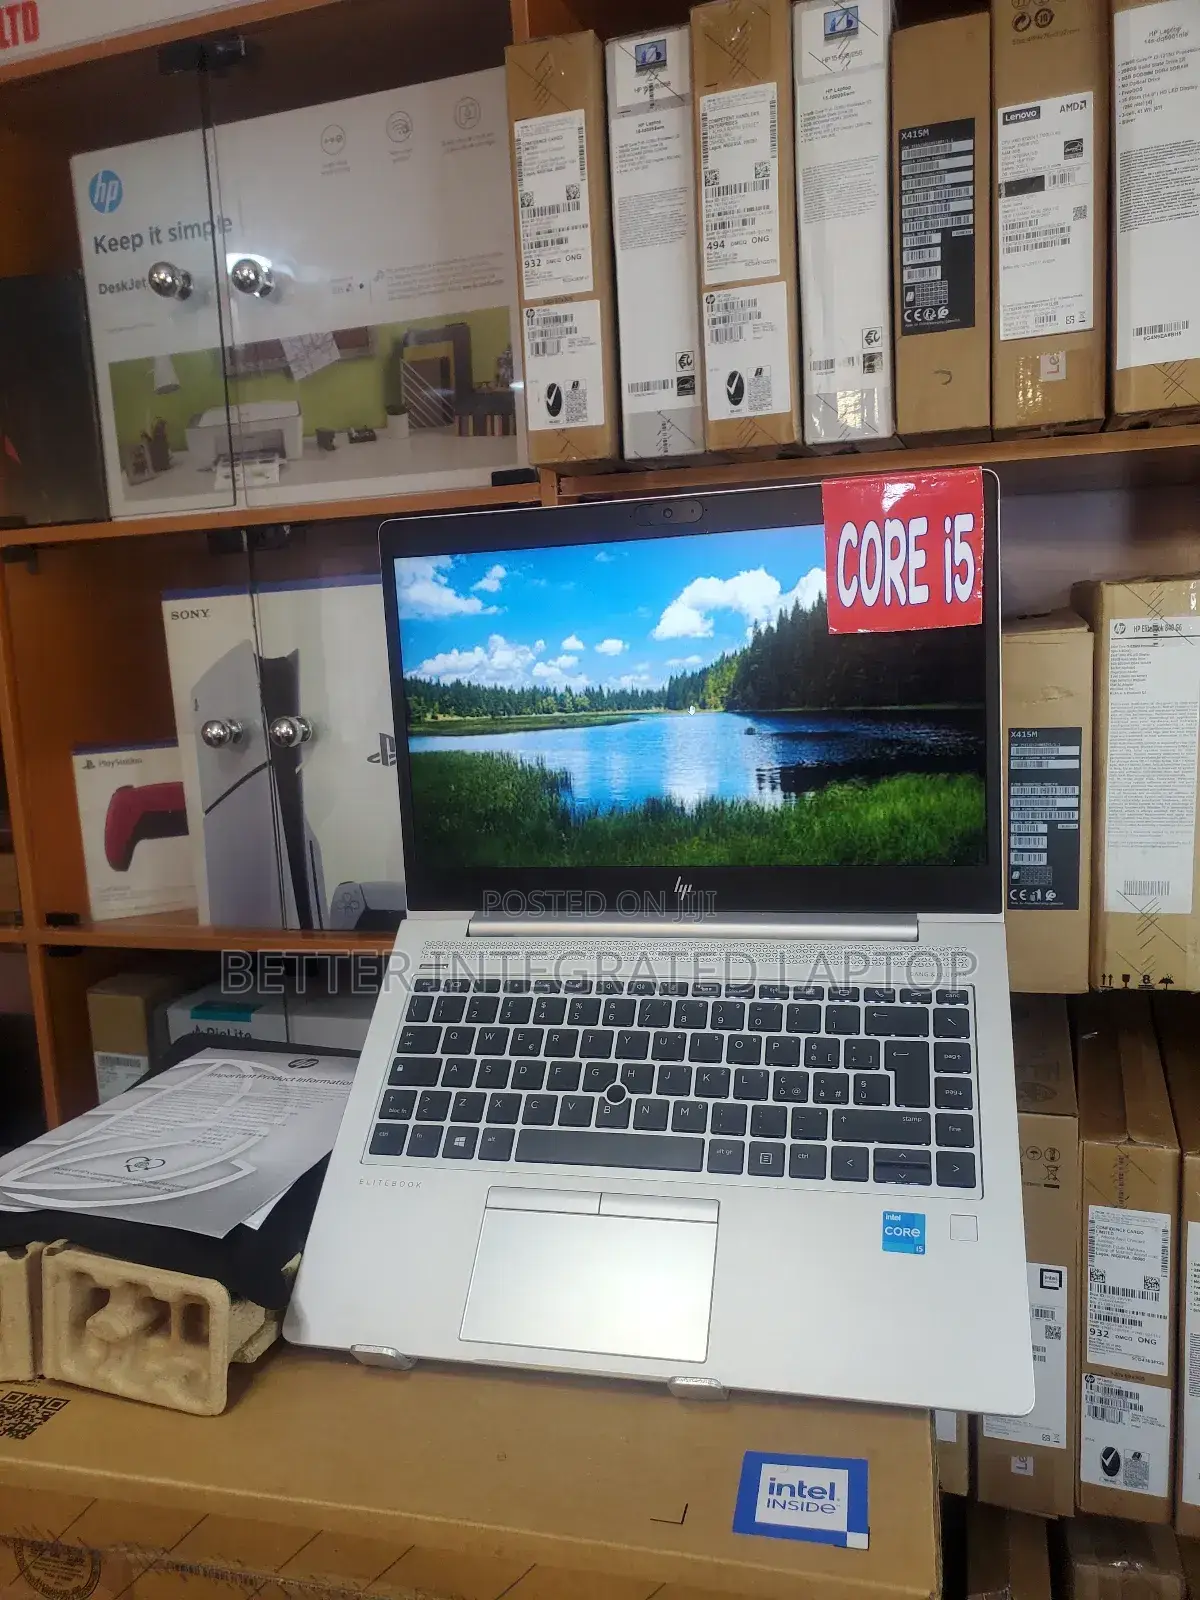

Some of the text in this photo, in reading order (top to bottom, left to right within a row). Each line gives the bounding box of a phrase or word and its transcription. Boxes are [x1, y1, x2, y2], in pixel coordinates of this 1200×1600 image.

[1005, 102, 1080, 122] Lenovo AMD
[901, 128, 930, 140] X415M
[93, 214, 234, 255] Keep it simple
[706, 239, 726, 250] 494
[751, 235, 770, 245] ONG
[524, 258, 542, 268] 932
[565, 253, 582, 262] ONG
[98, 277, 148, 296] DeskJet
[836, 512, 976, 608] CORE i5
[170, 608, 211, 621] SONY
[1133, 625, 1141, 633] HP
[471, 1010, 478, 1018] 2
[573, 1012, 580, 1020] 5
[608, 1013, 615, 1021] 6
[680, 1015, 687, 1023] 8
[717, 1016, 724, 1024] 9
[450, 1031, 458, 1040] Q
[484, 1032, 495, 1040] W
[517, 1033, 524, 1041] E
[552, 1034, 560, 1042] R
[587, 1035, 594, 1043] T
[623, 1036, 632, 1044] Y
[659, 1037, 667, 1045] U
[735, 1040, 743, 1049] O
[772, 1042, 780, 1050] P
[528, 1043, 535, 1051] €
[208, 1071, 257, 1082] Important
[257, 1073, 297, 1084] Product
[450, 1064, 458, 1073] A
[484, 1065, 492, 1073] S
[519, 1066, 528, 1074] D
[554, 1067, 562, 1075] F
[591, 1068, 600, 1076] G
[627, 1069, 636, 1078] H
[664, 1071, 671, 1080] J
[702, 1073, 711, 1082] K
[741, 1075, 748, 1084] L
[791, 1087, 801, 1096] @
[834, 1090, 842, 1098] #
[458, 1098, 922, 1123] Z X C V B N M stamp
[798, 1152, 809, 1160] ctrl
[358, 1178, 423, 1189] ELITEBOOK
[885, 1213, 902, 1222] intel
[1089, 1328, 1109, 1339] 932
[1137, 1336, 1157, 1346] ONG
[768, 1477, 836, 1502] intel
